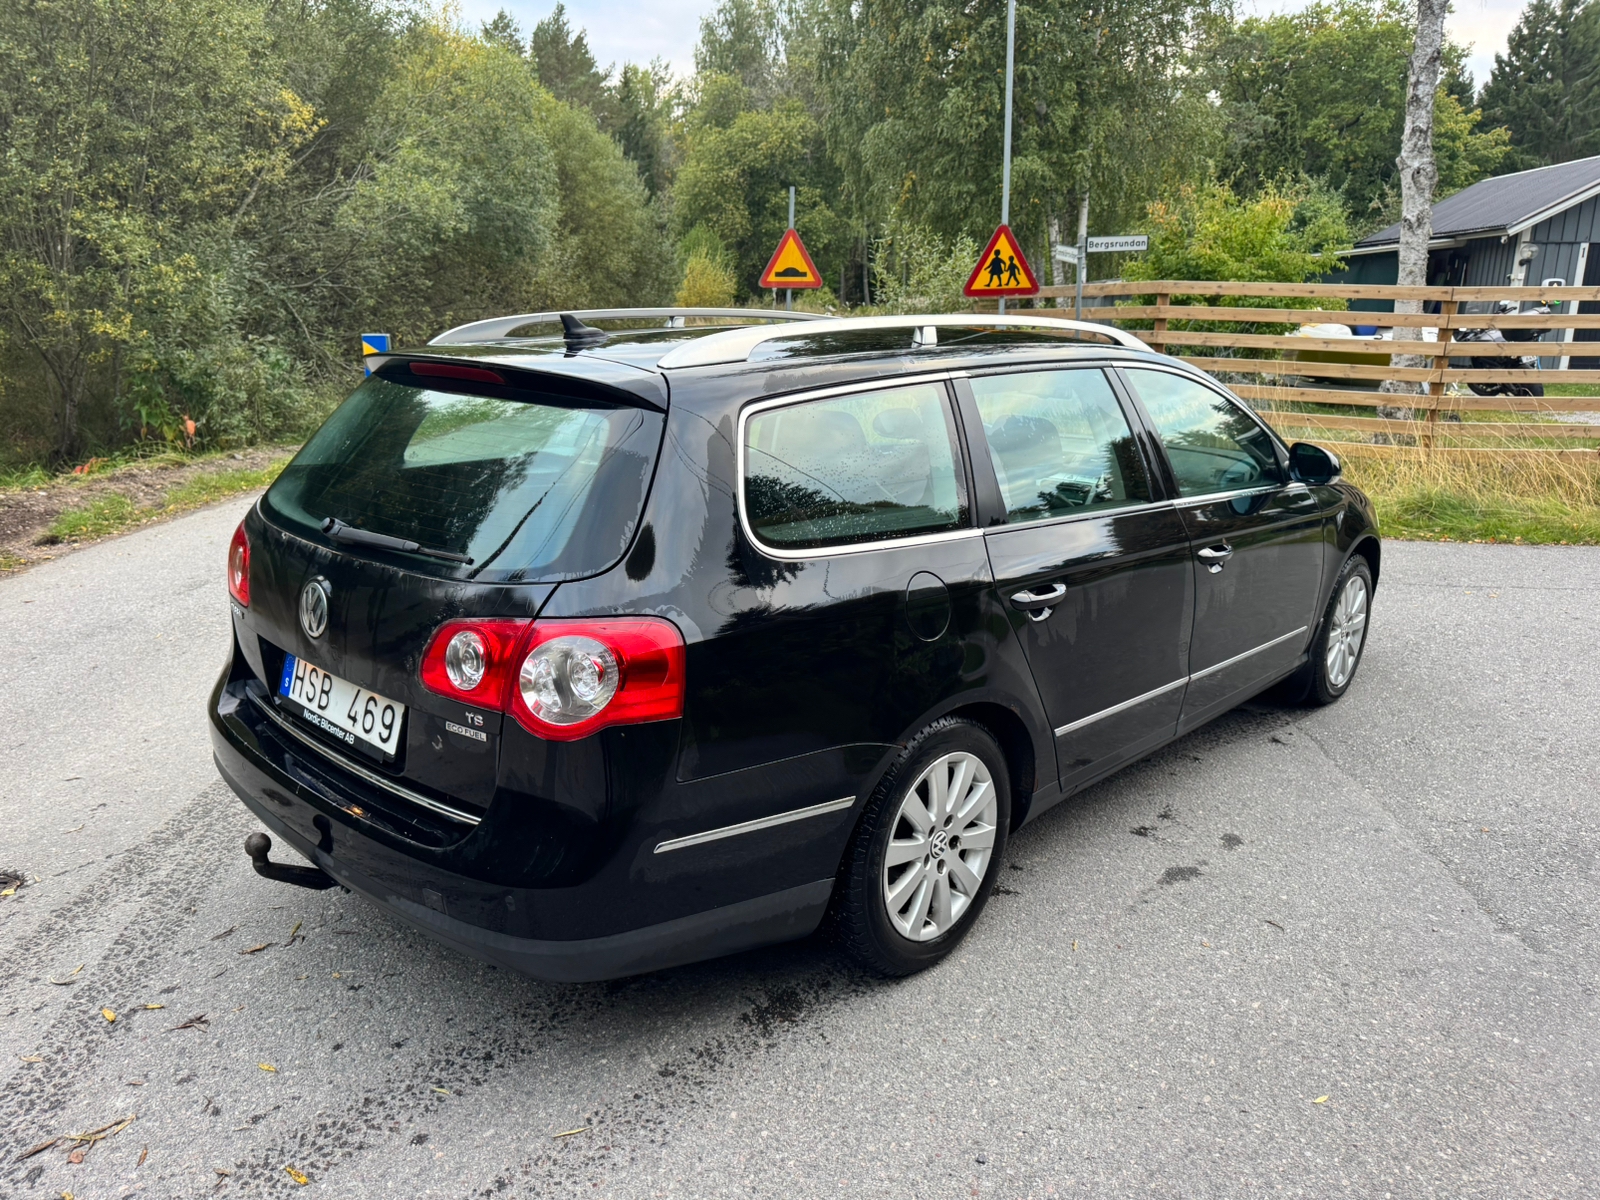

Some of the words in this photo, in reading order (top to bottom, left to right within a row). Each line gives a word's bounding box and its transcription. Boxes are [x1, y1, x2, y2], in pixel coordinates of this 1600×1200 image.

[1088, 240, 1146, 249] Bergsrundan
[284, 677, 290, 688] S
[292, 658, 333, 711] HSB
[347, 688, 396, 744] 469
[303, 709, 321, 725] Nordic
[320, 718, 345, 739] Bilcenter
[344, 732, 355, 745] AB
[447, 722, 463, 734] ECO
[464, 728, 485, 741] FUEL
